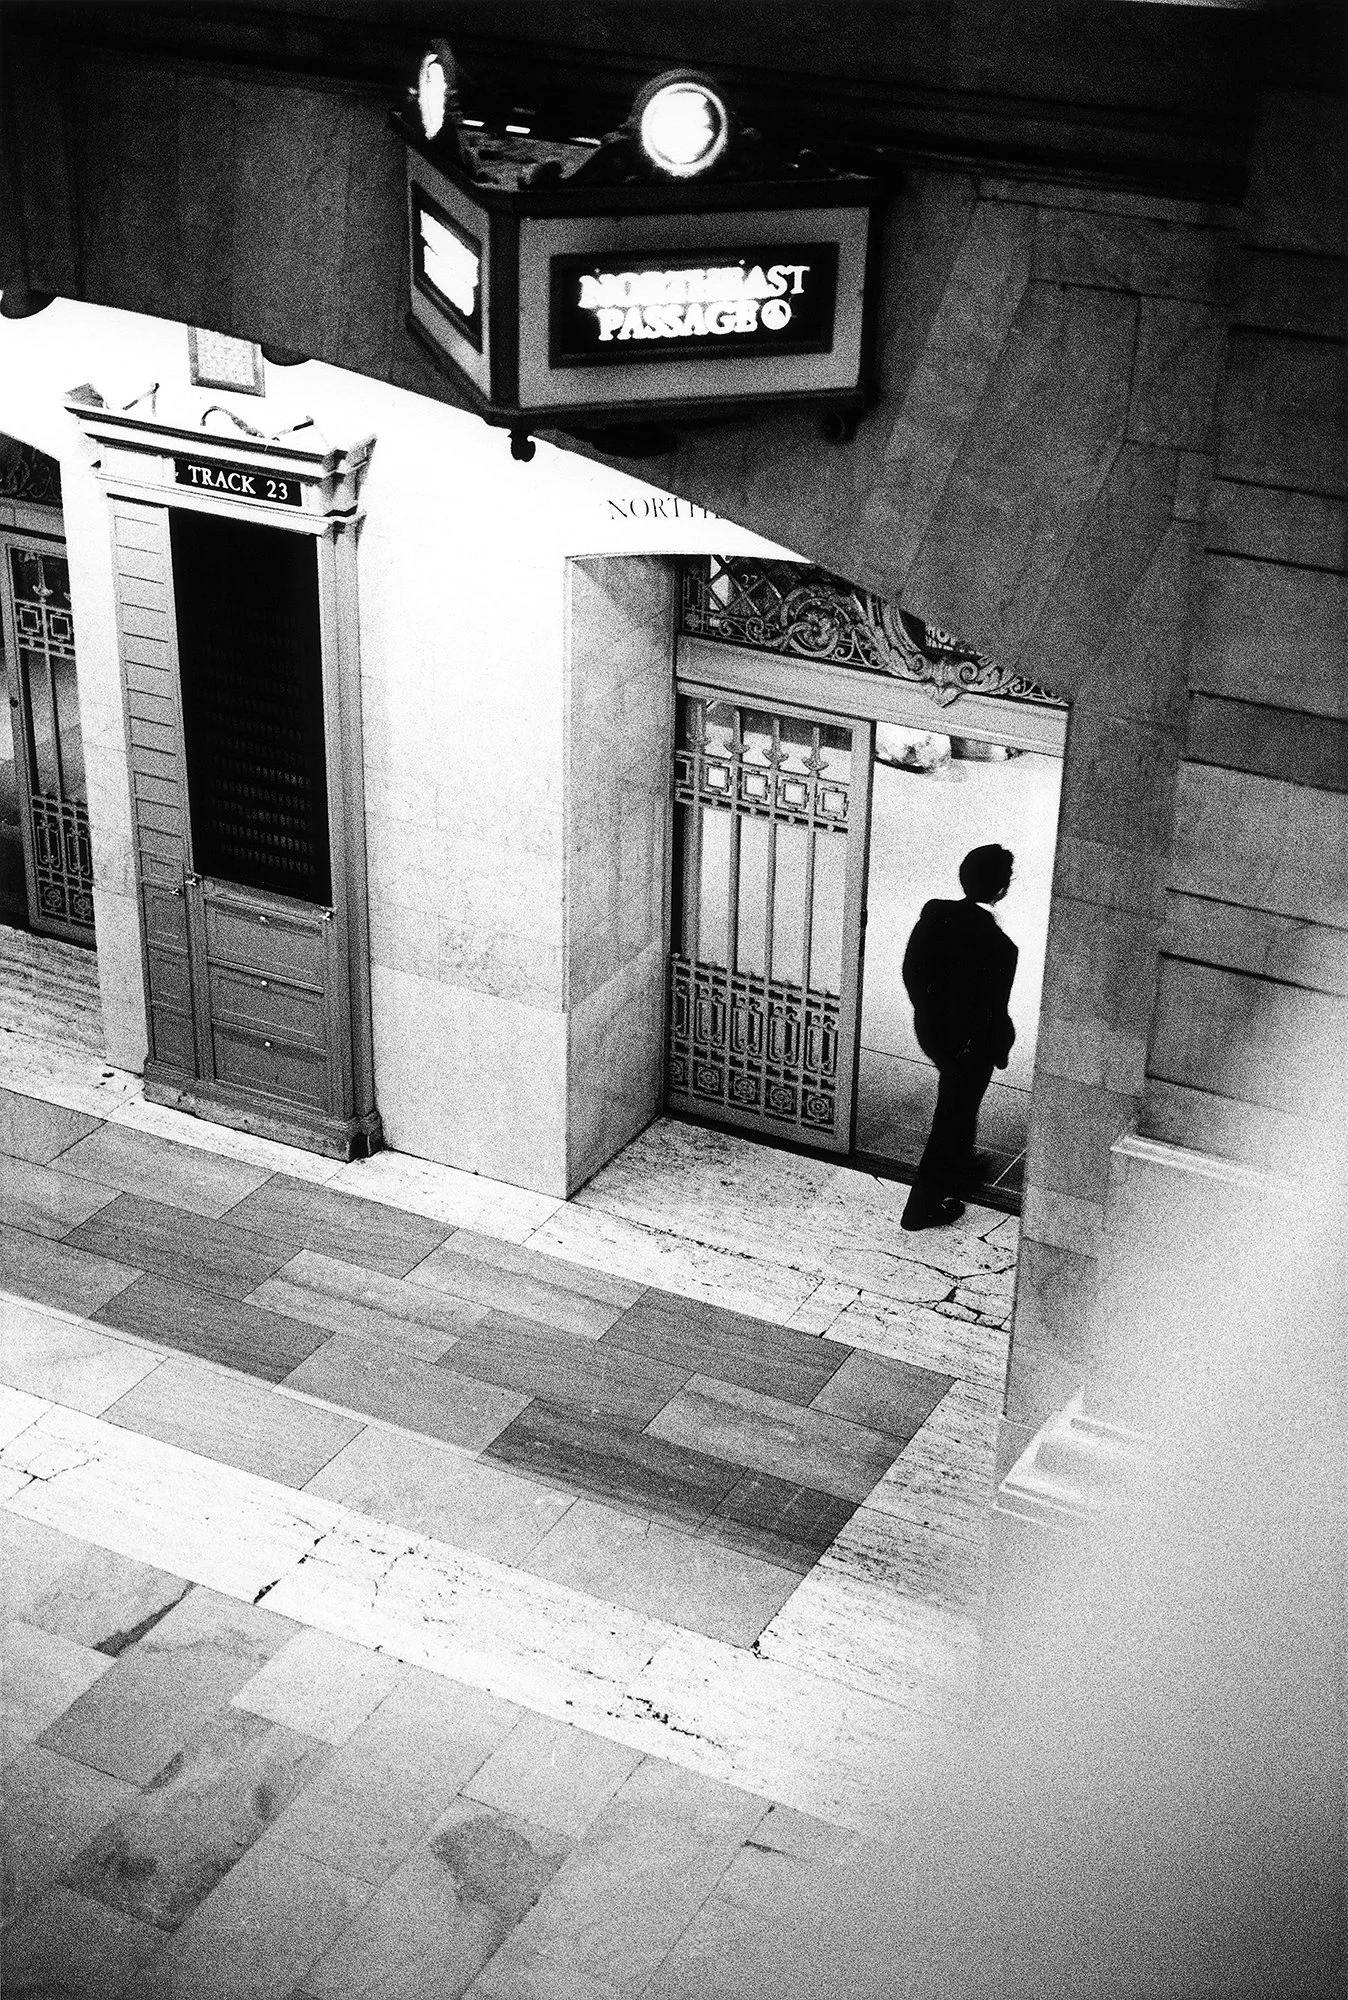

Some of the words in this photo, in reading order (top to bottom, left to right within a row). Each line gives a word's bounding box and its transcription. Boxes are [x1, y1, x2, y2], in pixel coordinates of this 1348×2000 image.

[597, 300, 760, 341] PASSAGE
[187, 464, 257, 495] TRACK
[265, 479, 289, 501] 23
